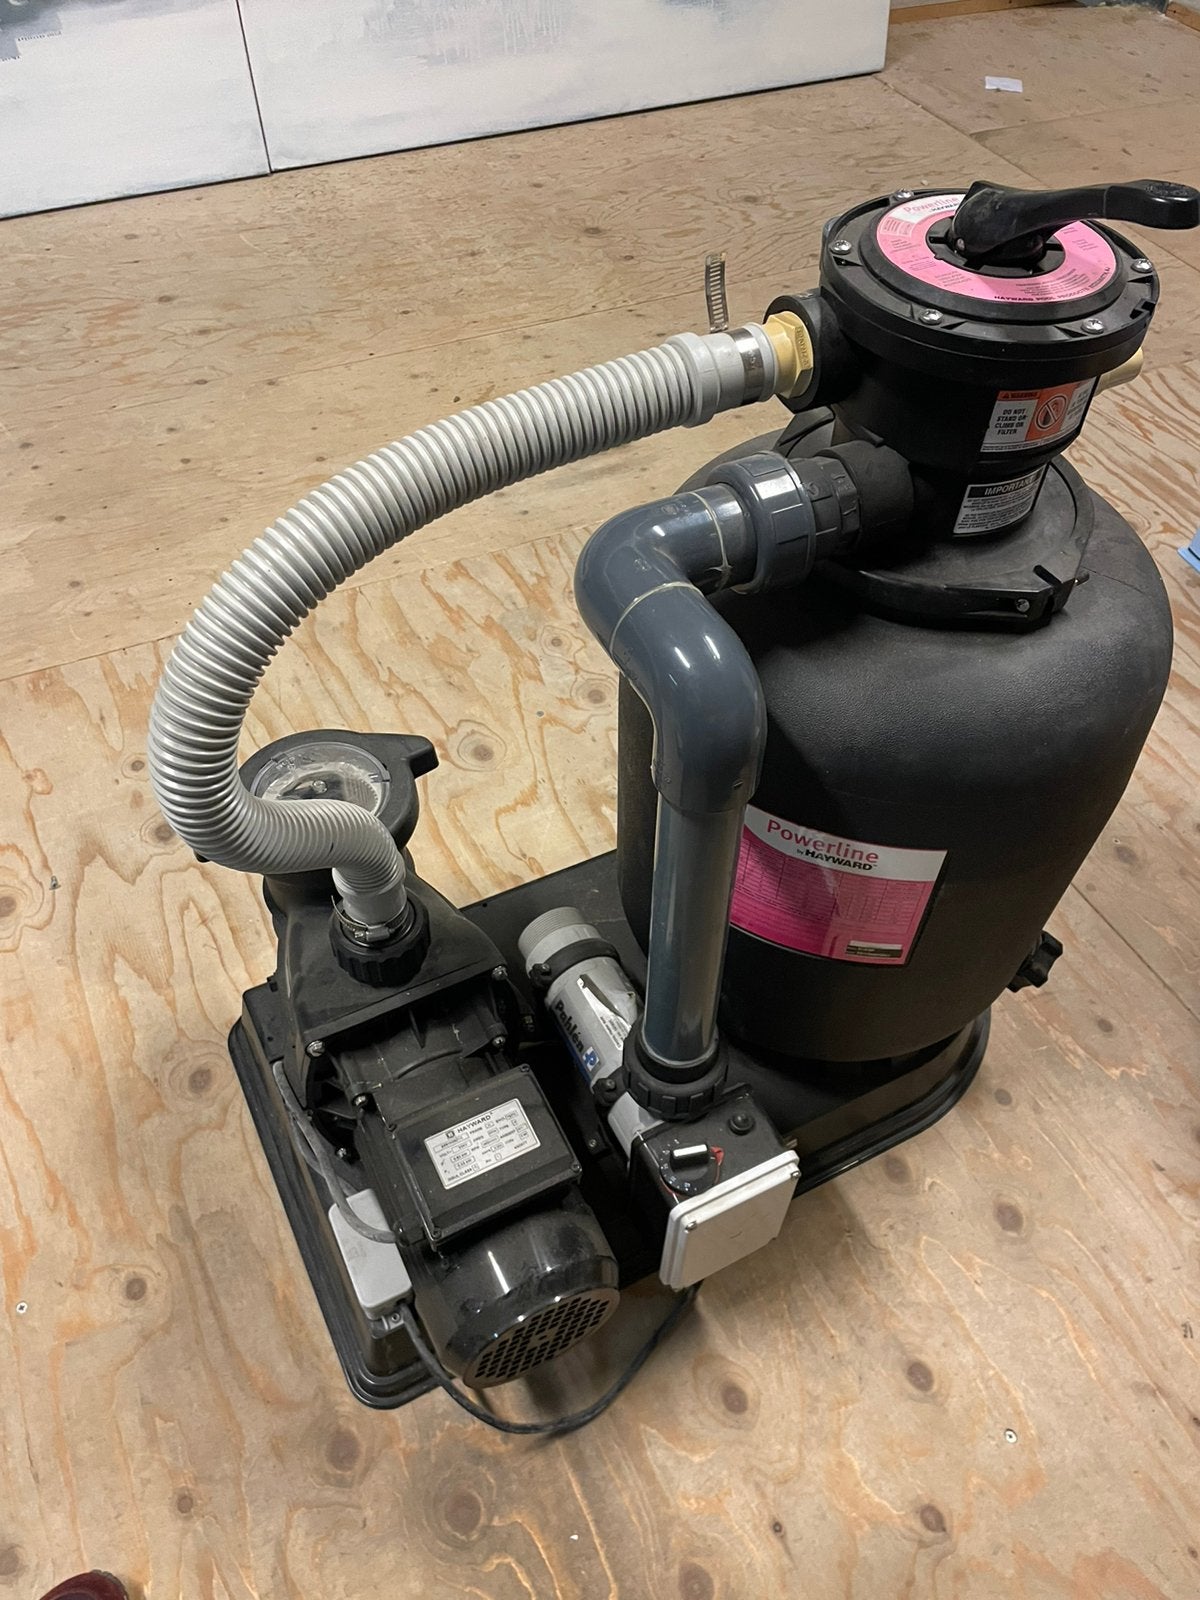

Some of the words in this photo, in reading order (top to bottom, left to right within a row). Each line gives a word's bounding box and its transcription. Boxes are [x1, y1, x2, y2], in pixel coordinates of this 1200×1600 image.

[984, 475, 1034, 496] IMPORTANT
[766, 819, 880, 864] Powerline
[805, 849, 873, 871] HAYWARD
[457, 1115, 491, 1132] HAYWARD
